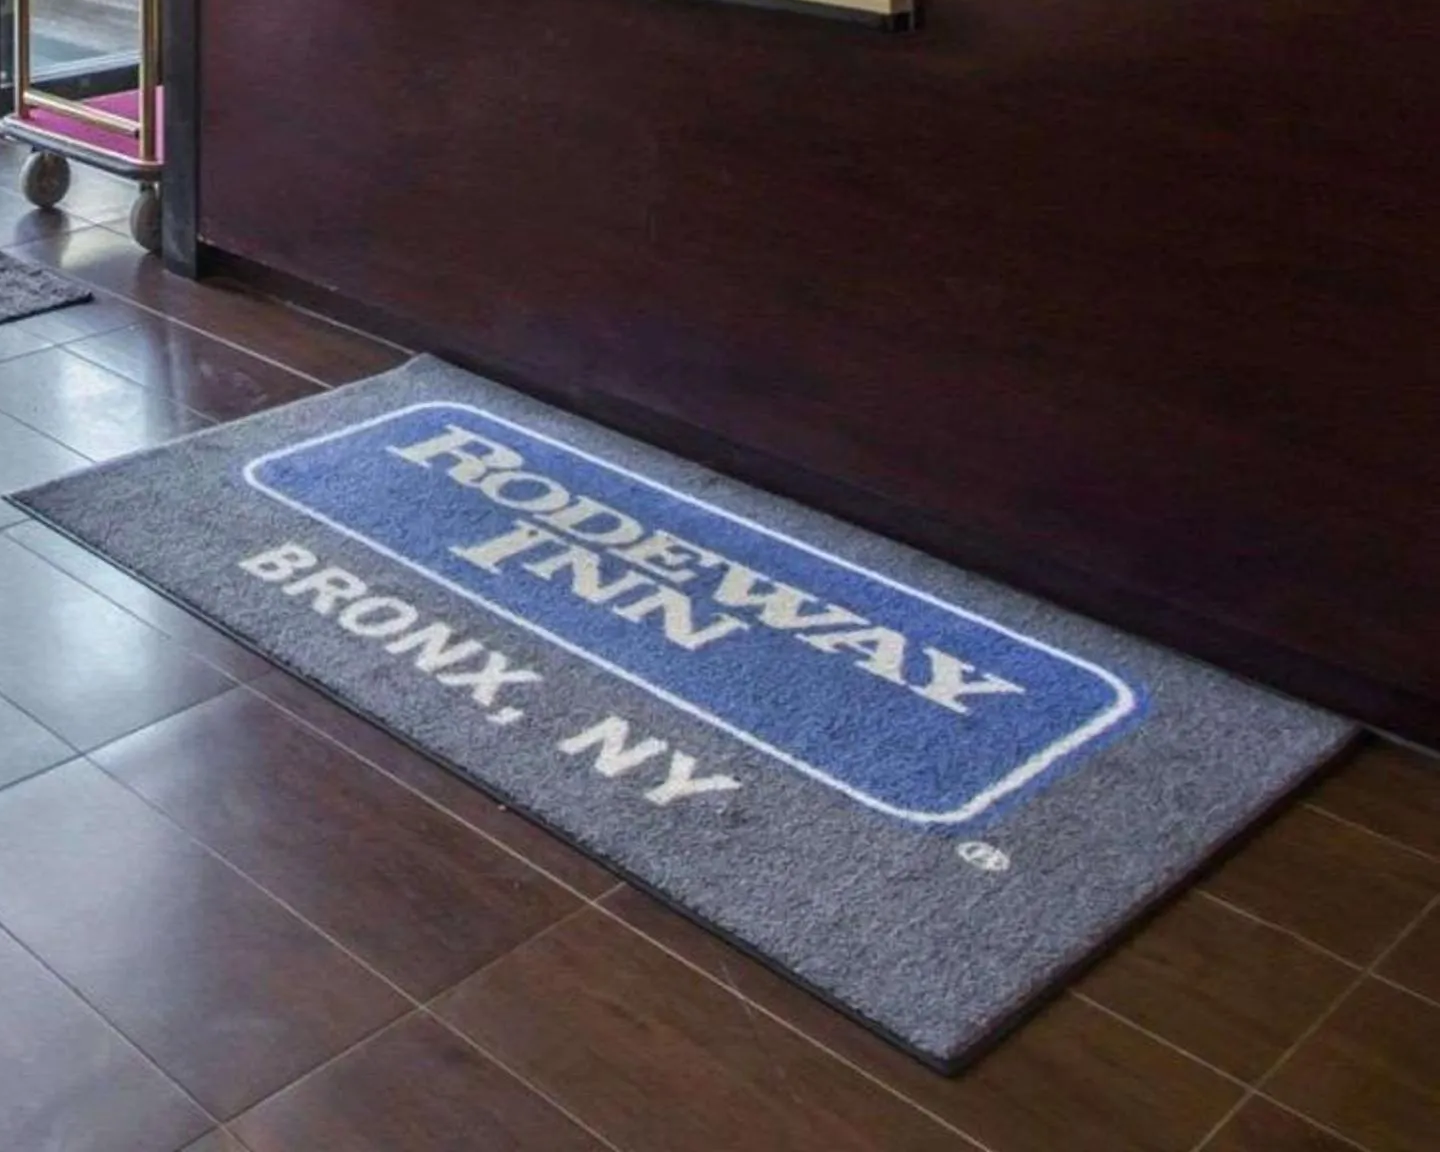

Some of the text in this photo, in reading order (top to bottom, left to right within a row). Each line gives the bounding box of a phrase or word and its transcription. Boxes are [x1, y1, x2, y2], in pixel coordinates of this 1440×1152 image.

[239, 543, 741, 808] BRONX, NY
[388, 425, 1025, 713] RODEWAY
[452, 520, 752, 651] INN
